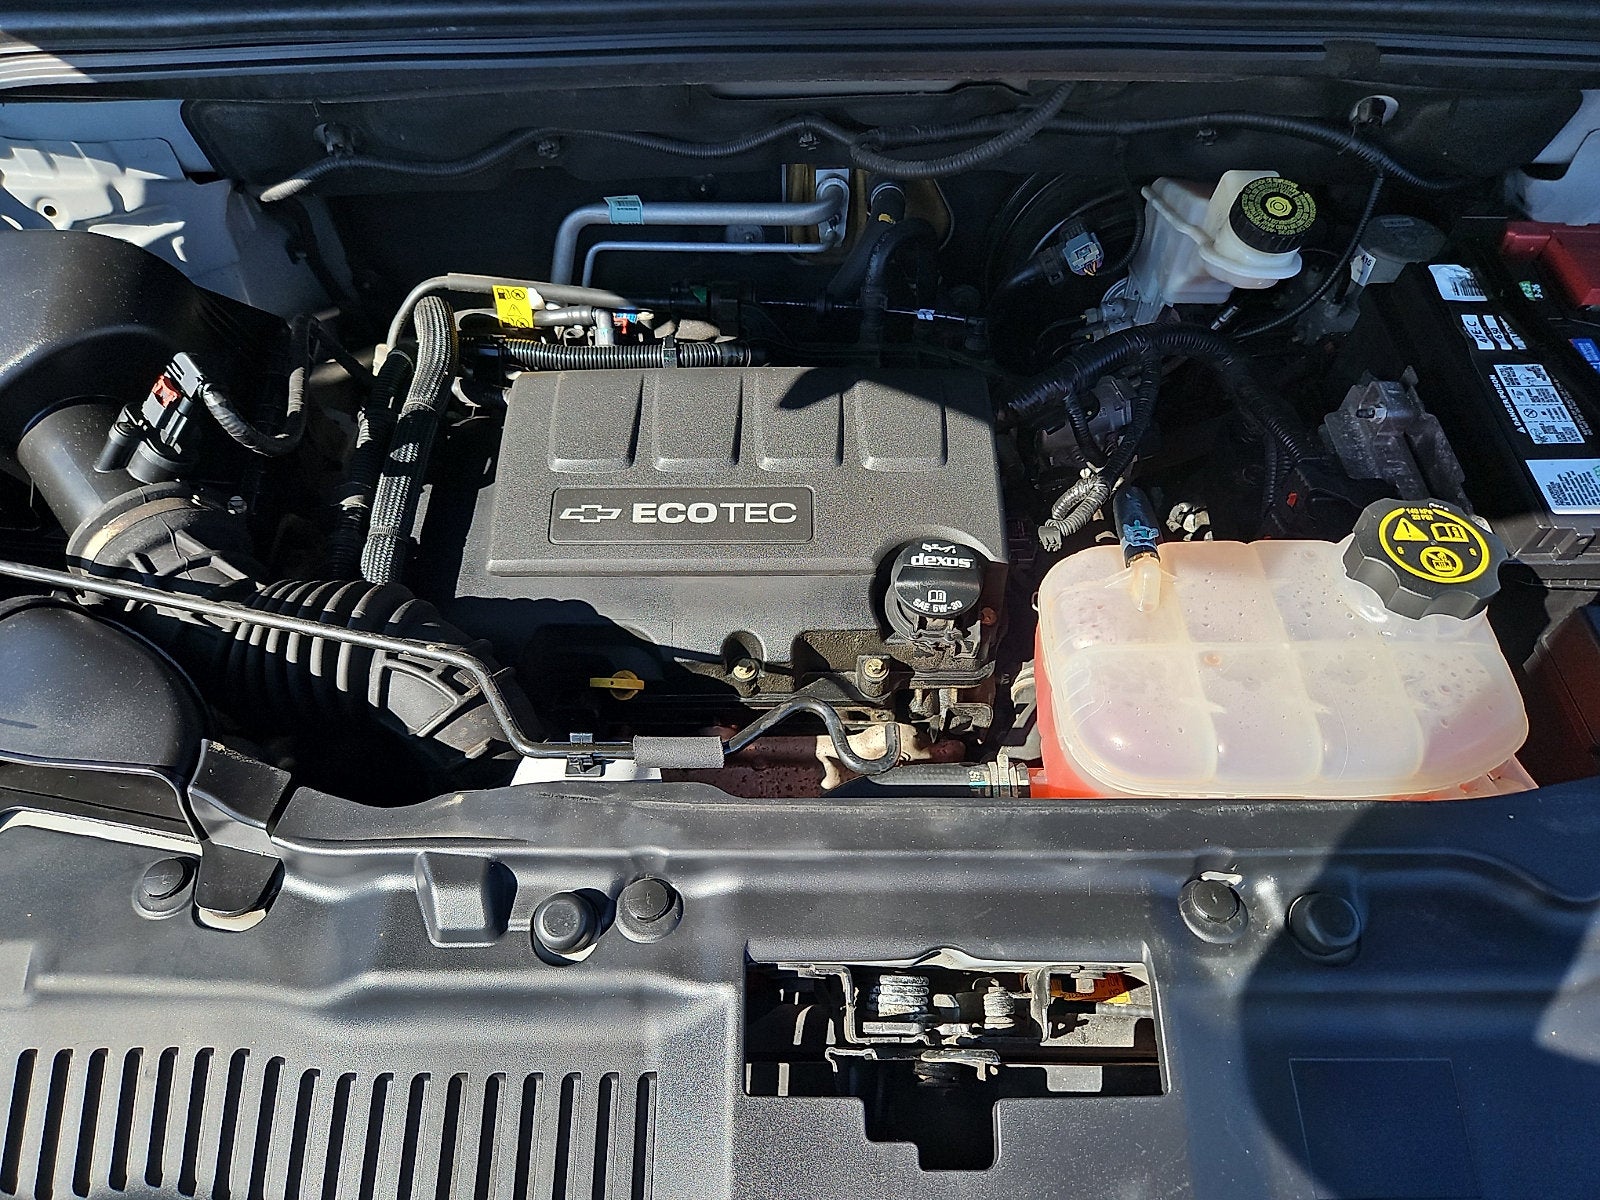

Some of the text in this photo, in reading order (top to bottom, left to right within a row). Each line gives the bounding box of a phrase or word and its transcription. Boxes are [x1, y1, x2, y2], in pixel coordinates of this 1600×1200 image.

[631, 502, 797, 524] ECOTEC
[910, 553, 972, 568] dexos
[912, 598, 963, 613] SAE 5W-30
